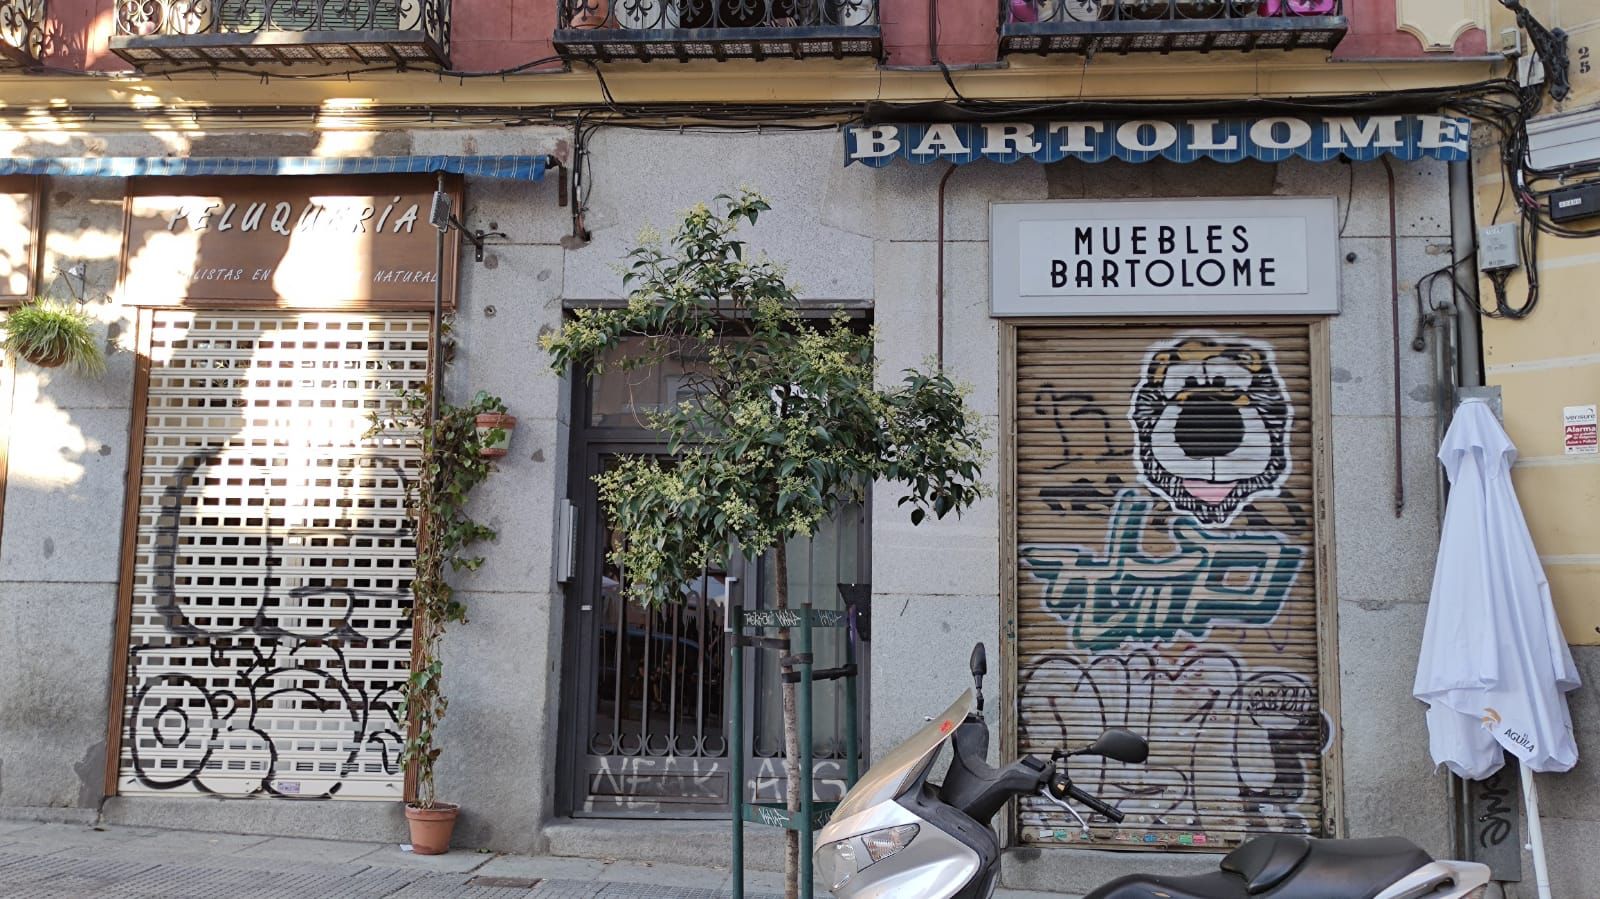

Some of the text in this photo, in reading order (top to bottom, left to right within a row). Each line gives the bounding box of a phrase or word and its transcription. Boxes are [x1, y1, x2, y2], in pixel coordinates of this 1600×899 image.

[850, 116, 1469, 157] BARTOLOME
[167, 196, 419, 236] PELUQURÍA
[1075, 224, 1248, 255] MUEBLES
[251, 268, 272, 281] EN
[373, 270, 438, 283] NATURAL
[1050, 258, 1276, 288] BARTOLOME
